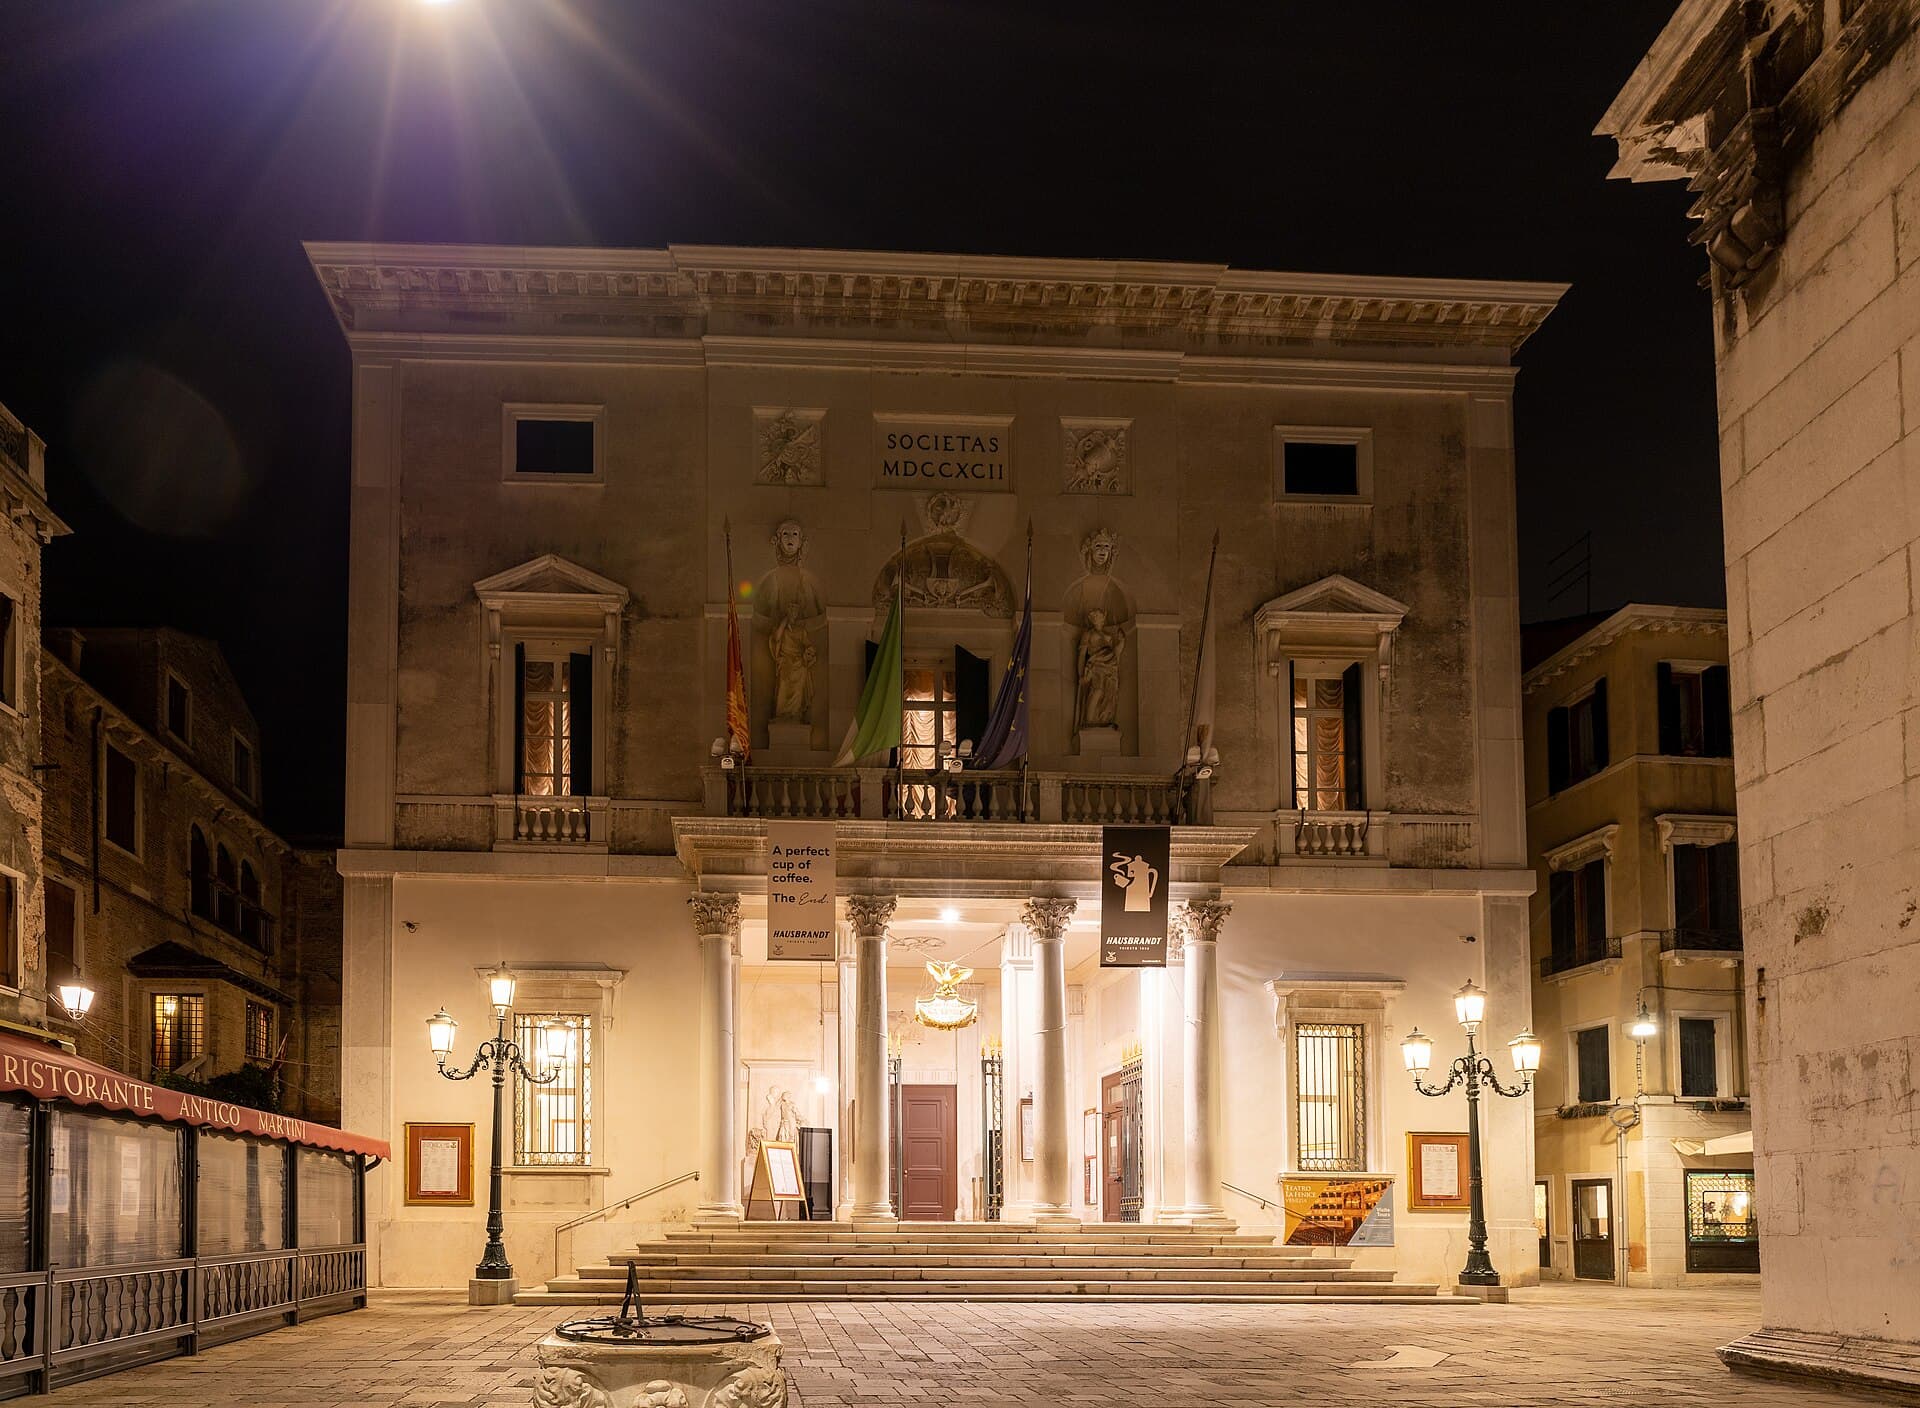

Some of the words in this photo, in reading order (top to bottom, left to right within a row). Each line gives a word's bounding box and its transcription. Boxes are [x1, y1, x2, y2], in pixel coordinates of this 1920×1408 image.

[887, 433, 999, 453] SOCIETAS
[883, 460, 1003, 480] MDCCXCII
[772, 846, 781, 855] A
[785, 846, 830, 857] perfect
[772, 861, 794, 871] cup
[798, 860, 811, 869] of
[772, 873, 813, 883] coffee.
[772, 893, 796, 903] The
[773, 930, 830, 938] HAUSBRANDT
[1106, 936, 1162, 944] HAUSBRANDT
[3, 1054, 154, 1110] RISTORANTE
[179, 1095, 240, 1126] ANTICO
[258, 1111, 306, 1139] MARTINI
